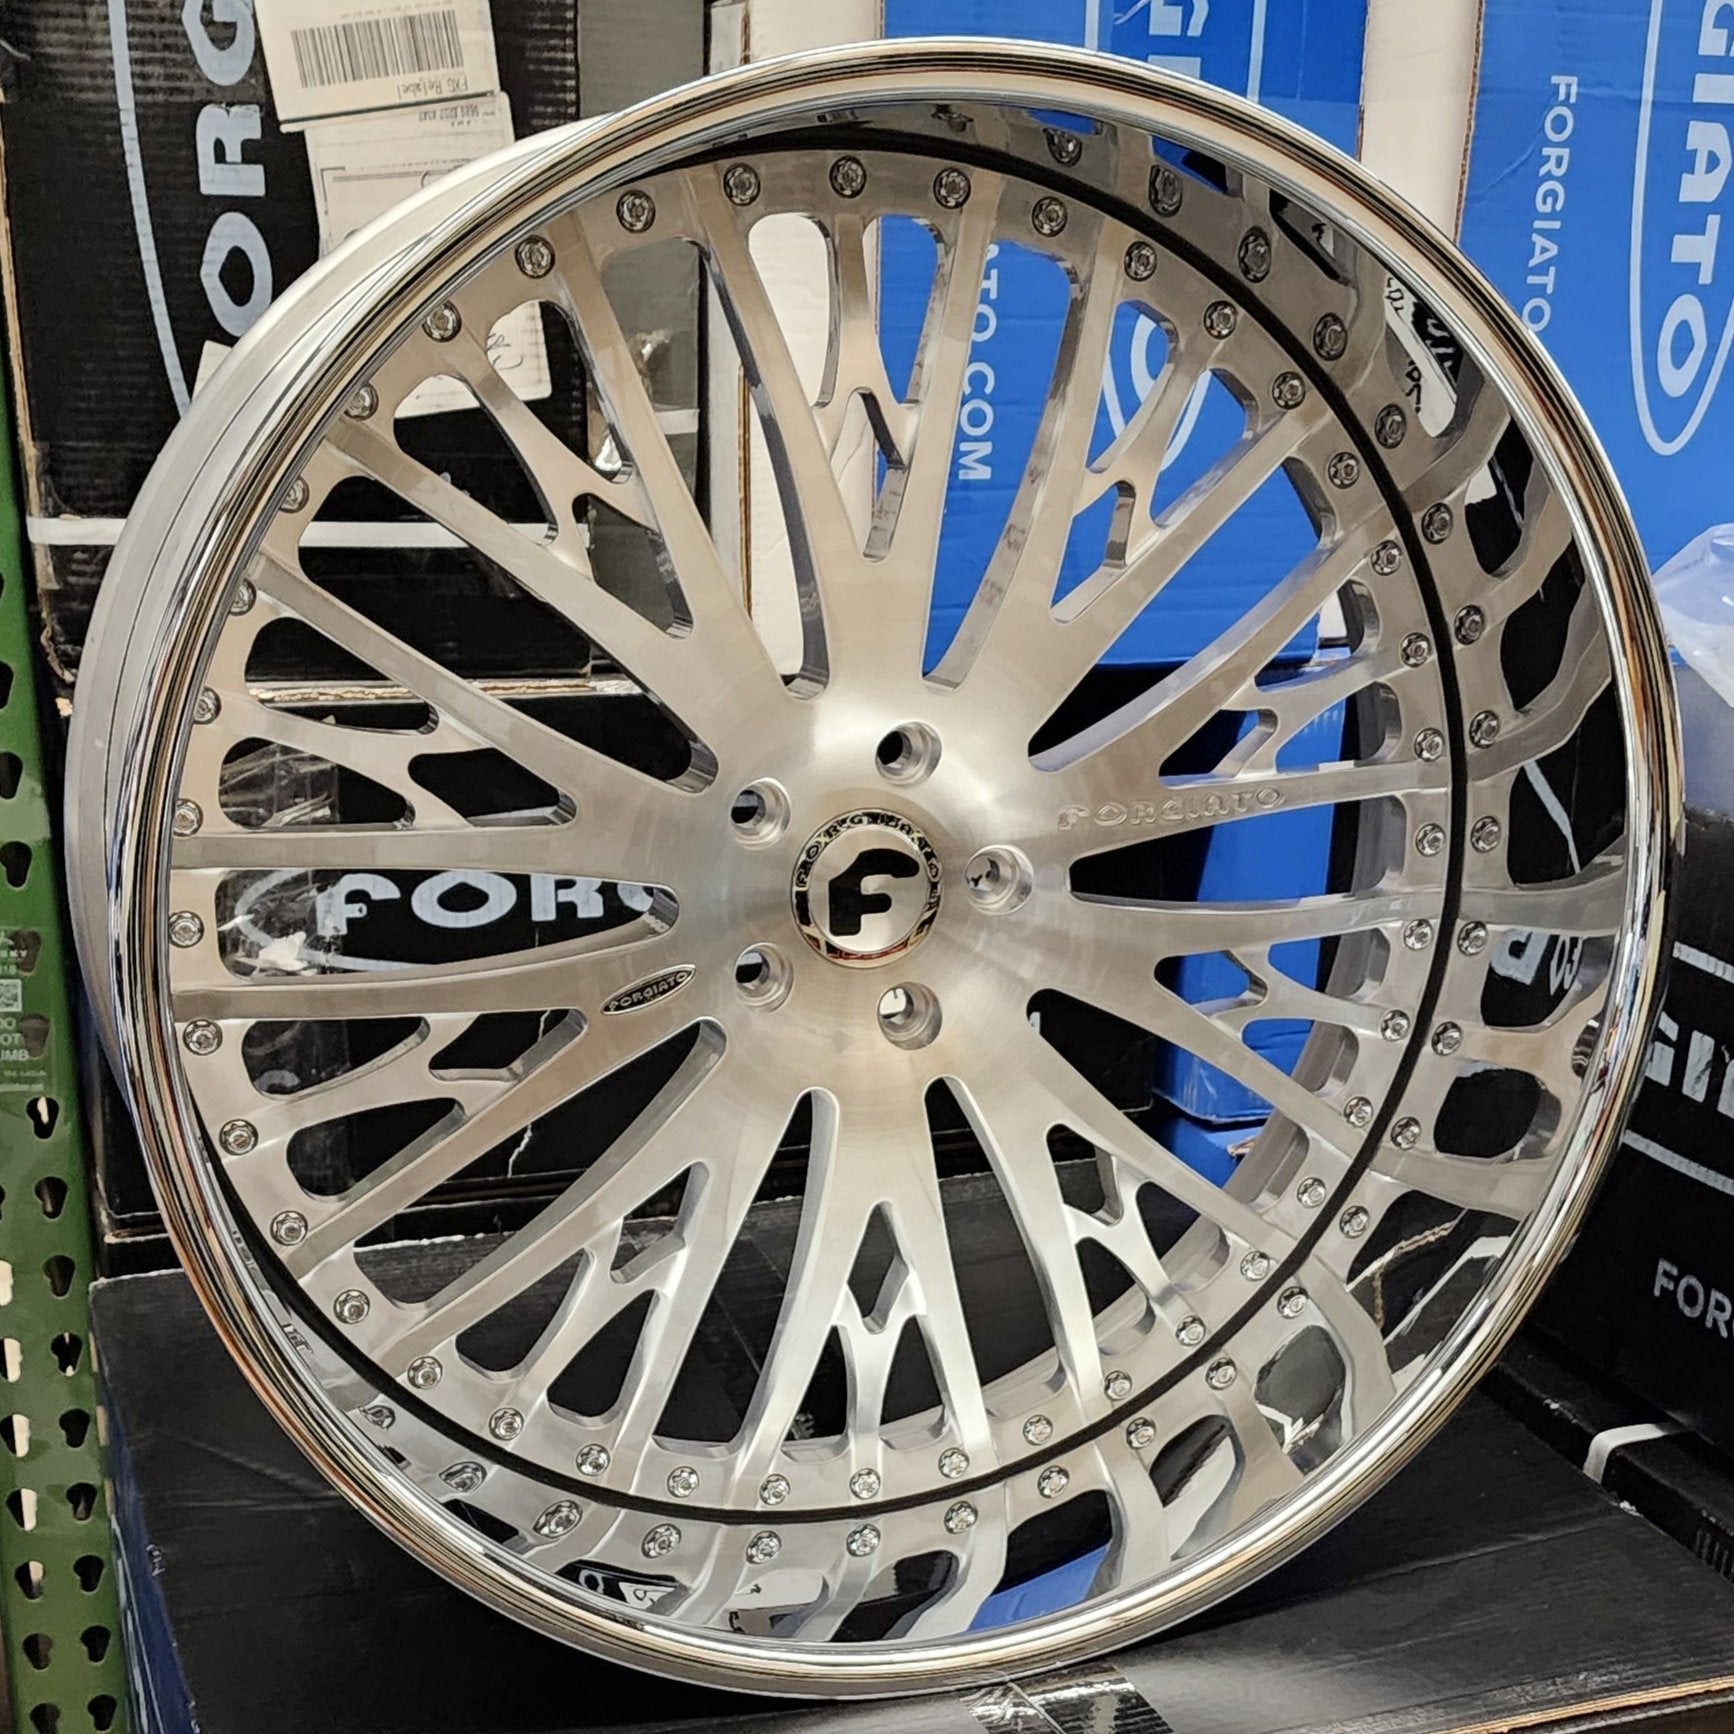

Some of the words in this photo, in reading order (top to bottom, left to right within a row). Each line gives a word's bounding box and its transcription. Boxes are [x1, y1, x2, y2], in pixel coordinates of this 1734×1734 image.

[1521, 74, 1580, 334] FORGIATO
[1057, 787, 1286, 832] FORGIATO
[828, 848, 920, 937] F
[608, 971, 689, 1012] FORGIATO
[1654, 1258, 1734, 1339] FOR
